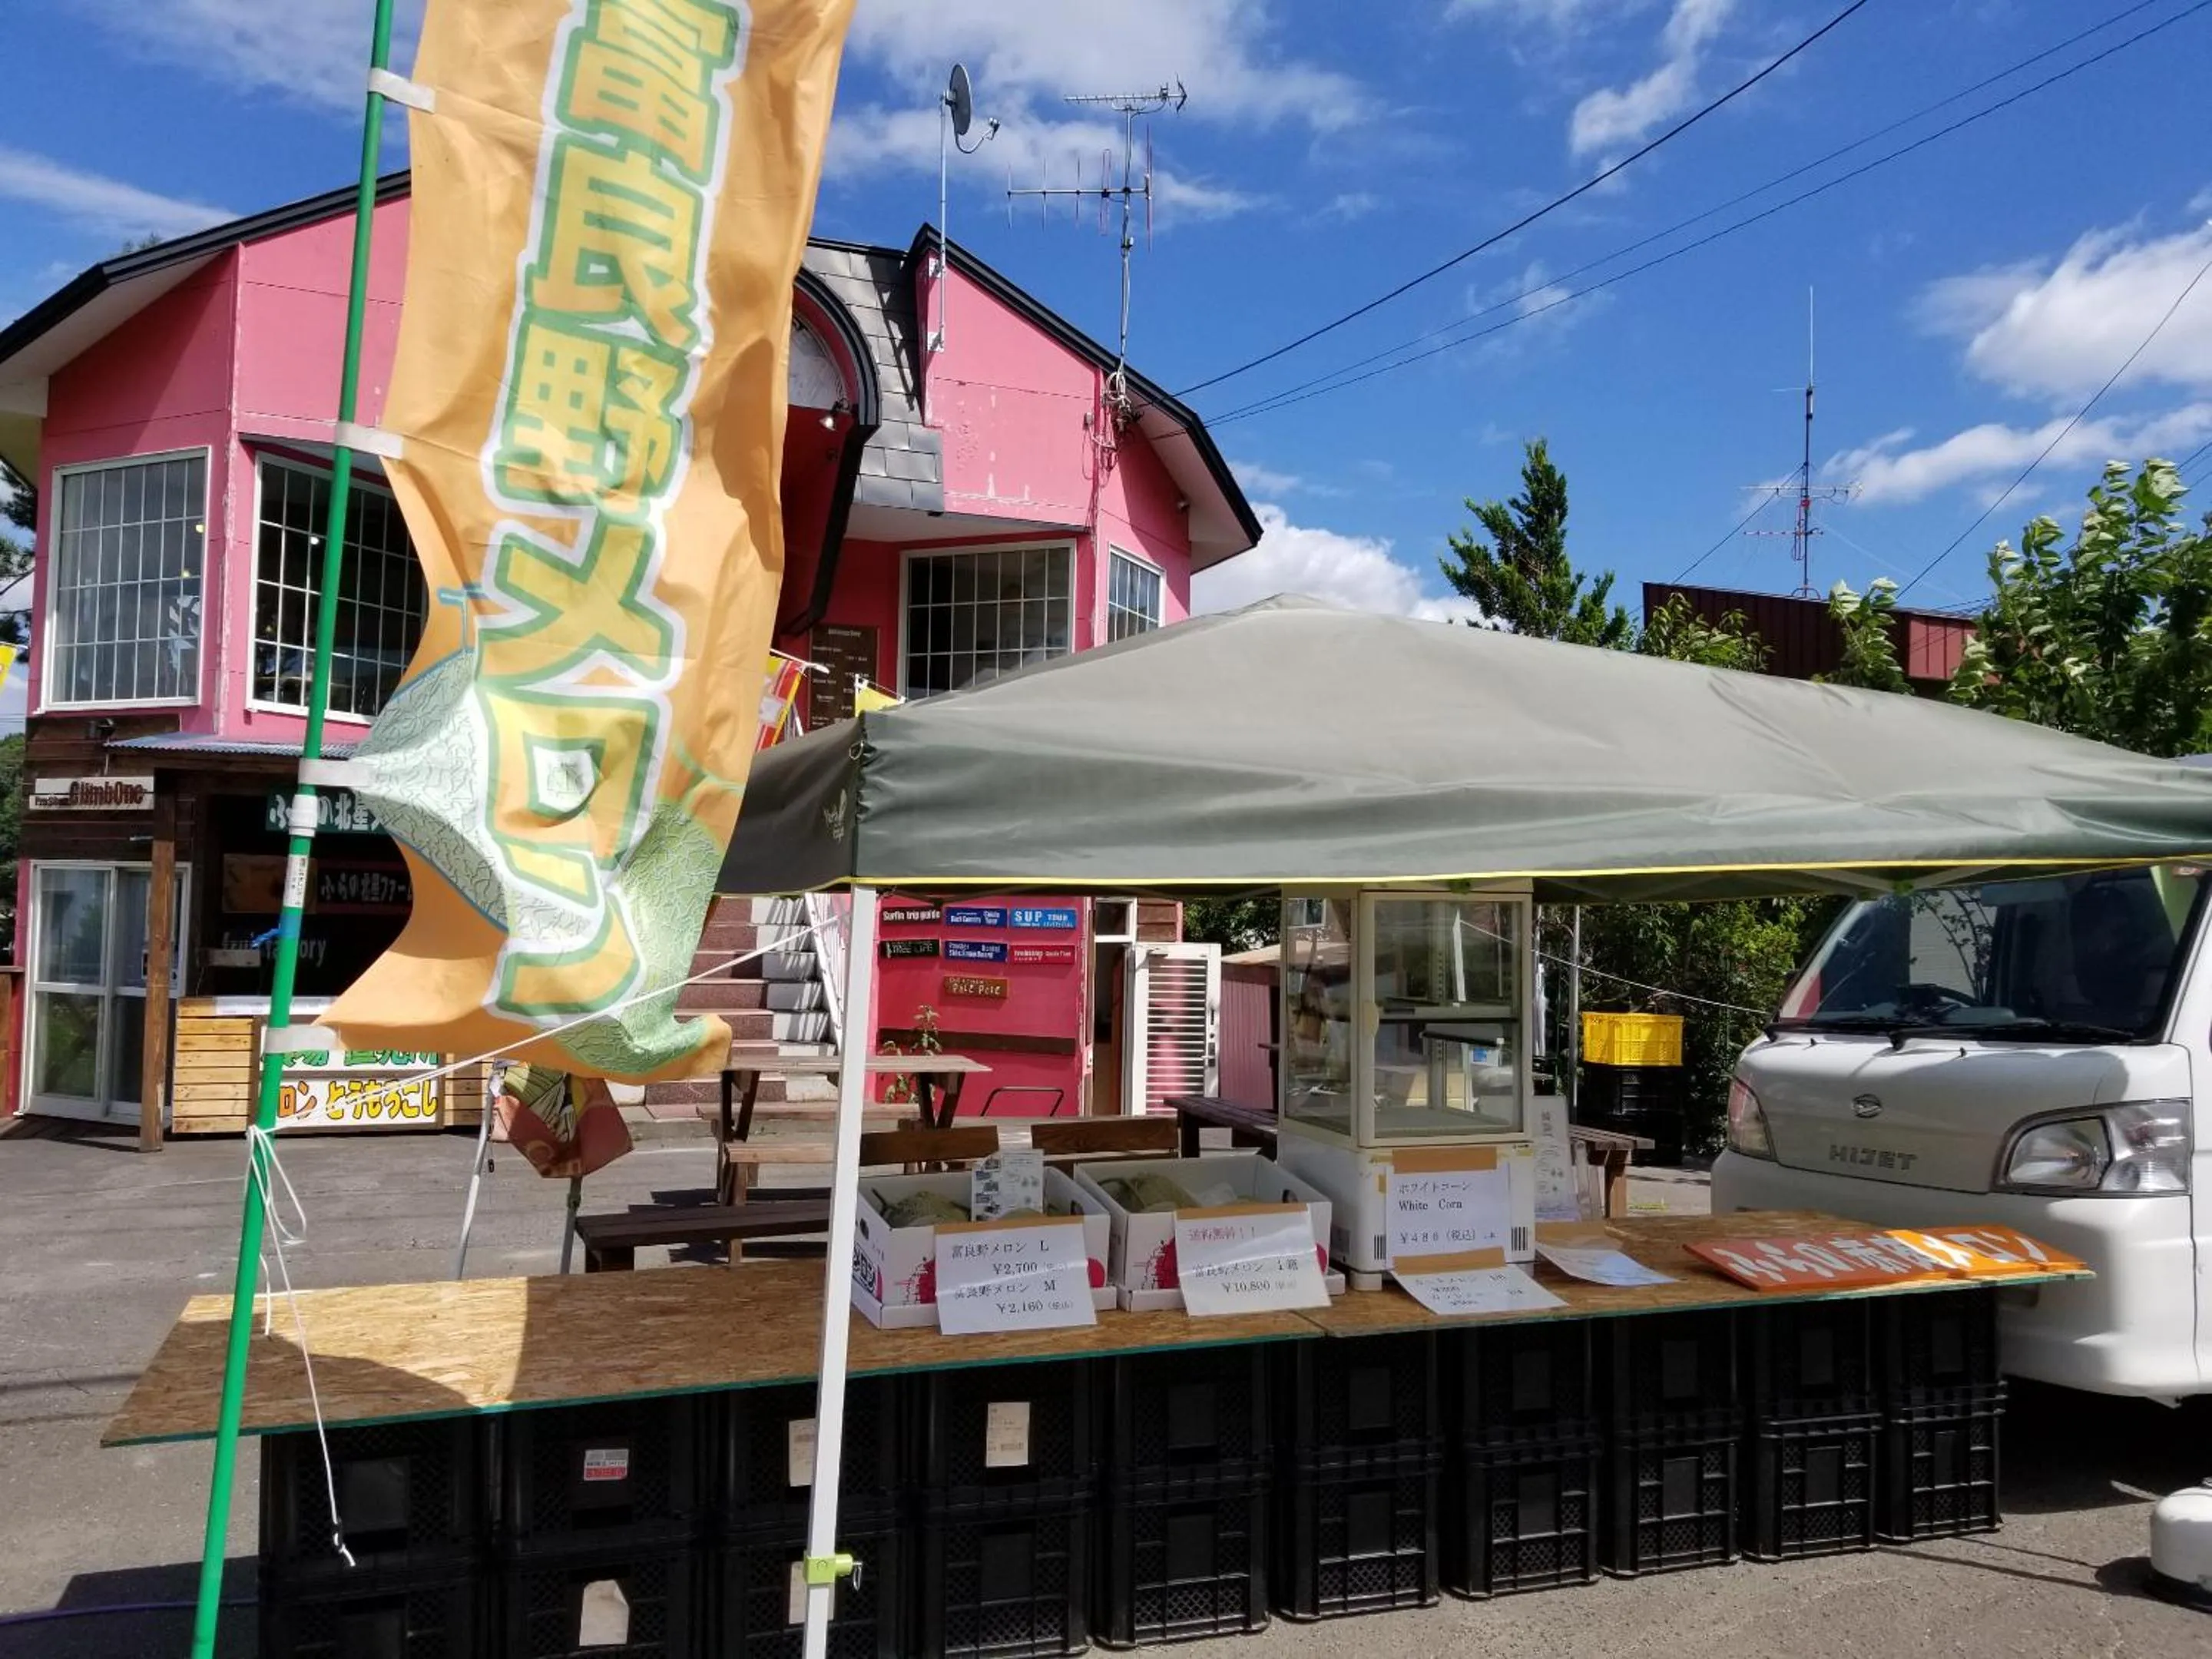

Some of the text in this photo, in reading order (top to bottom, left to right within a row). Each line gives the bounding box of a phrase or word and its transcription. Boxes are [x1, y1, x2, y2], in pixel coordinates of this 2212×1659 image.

[478, 0, 743, 1014] 富良野メロン
[320, 873, 412, 902] ふらの北星ファー
[1015, 910, 1042, 922] SUP
[279, 1079, 438, 1120] ロン とうもろこし
[1829, 1144, 1918, 1171] HIJET
[1399, 1198, 1463, 1212] White Corn
[952, 1240, 1050, 1260] 富良野メロン L
[1044, 1280, 1056, 1292] M
